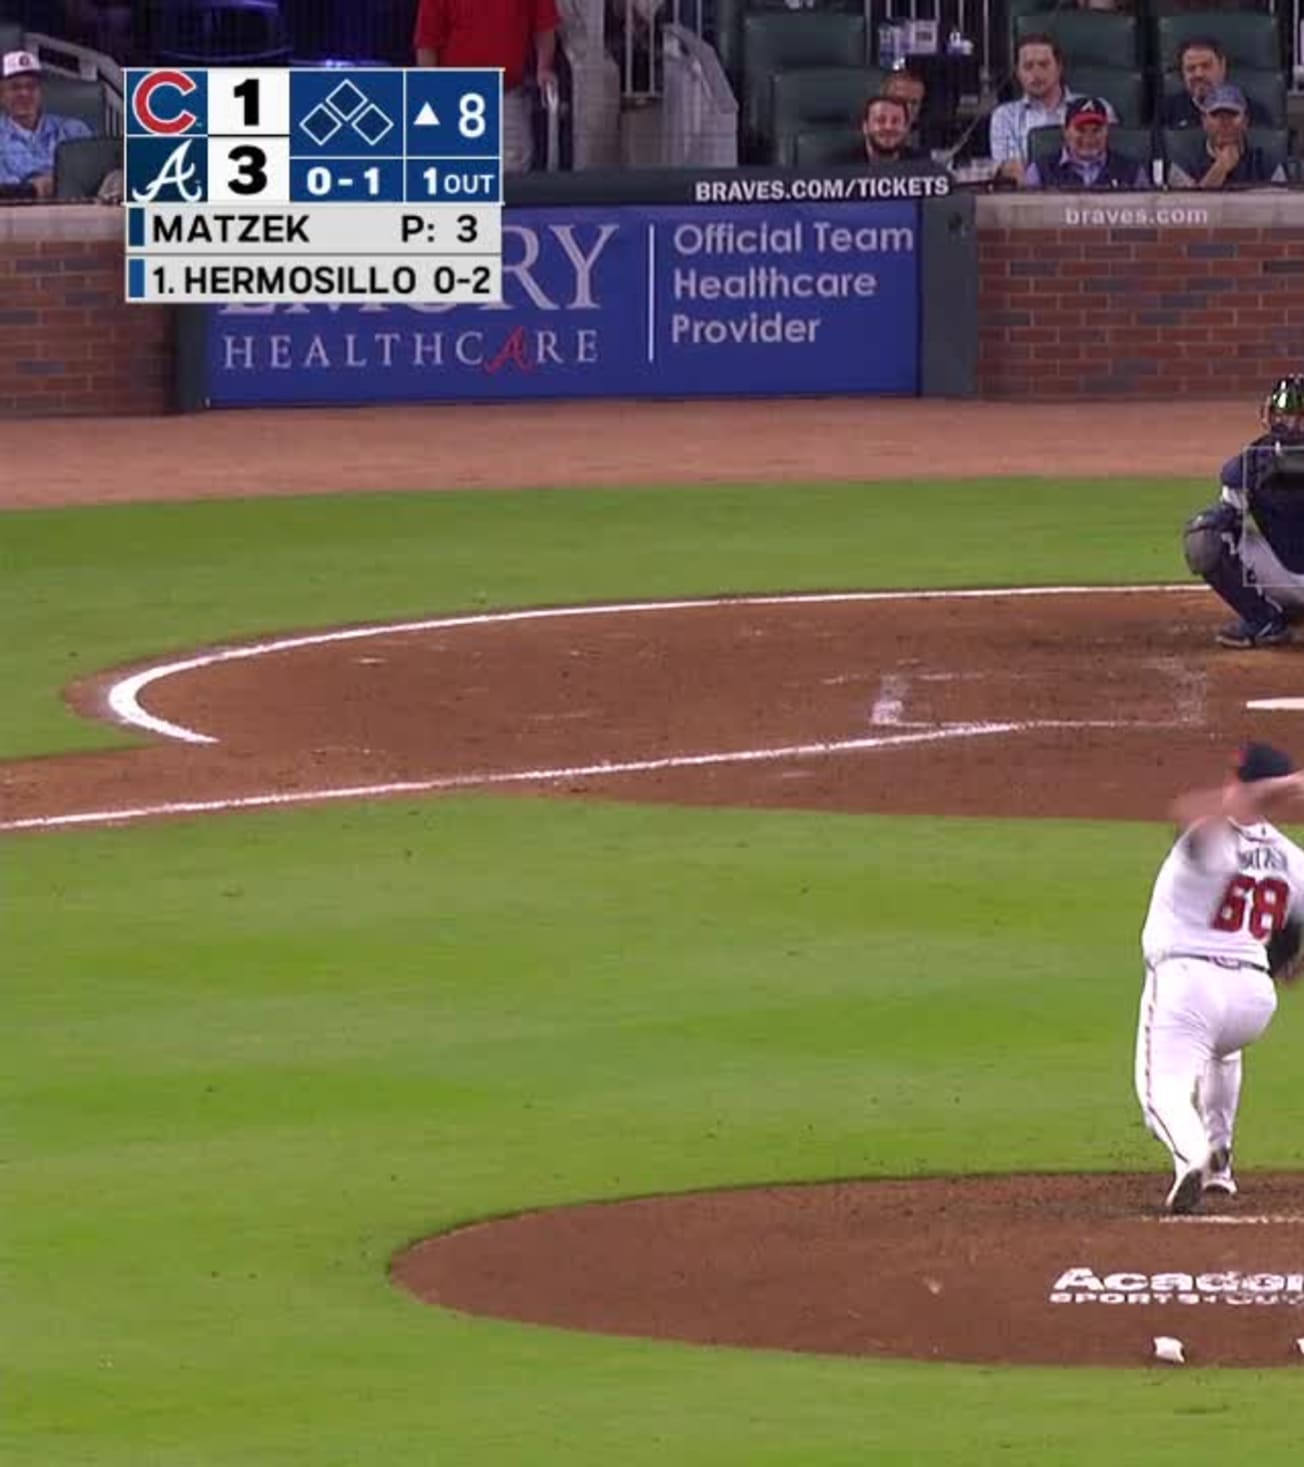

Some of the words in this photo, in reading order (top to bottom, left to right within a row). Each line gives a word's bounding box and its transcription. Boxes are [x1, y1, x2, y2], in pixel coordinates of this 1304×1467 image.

[695, 175, 949, 202] BRAVES.COM/TICKETS
[1065, 206, 1209, 225] braves.com
[673, 221, 801, 254] Official
[814, 221, 914, 252] Team
[674, 268, 877, 299] Healthcare
[671, 313, 822, 345] Provider
[222, 325, 598, 375] HEALTHCARE
[1211, 873, 1290, 940] 68
